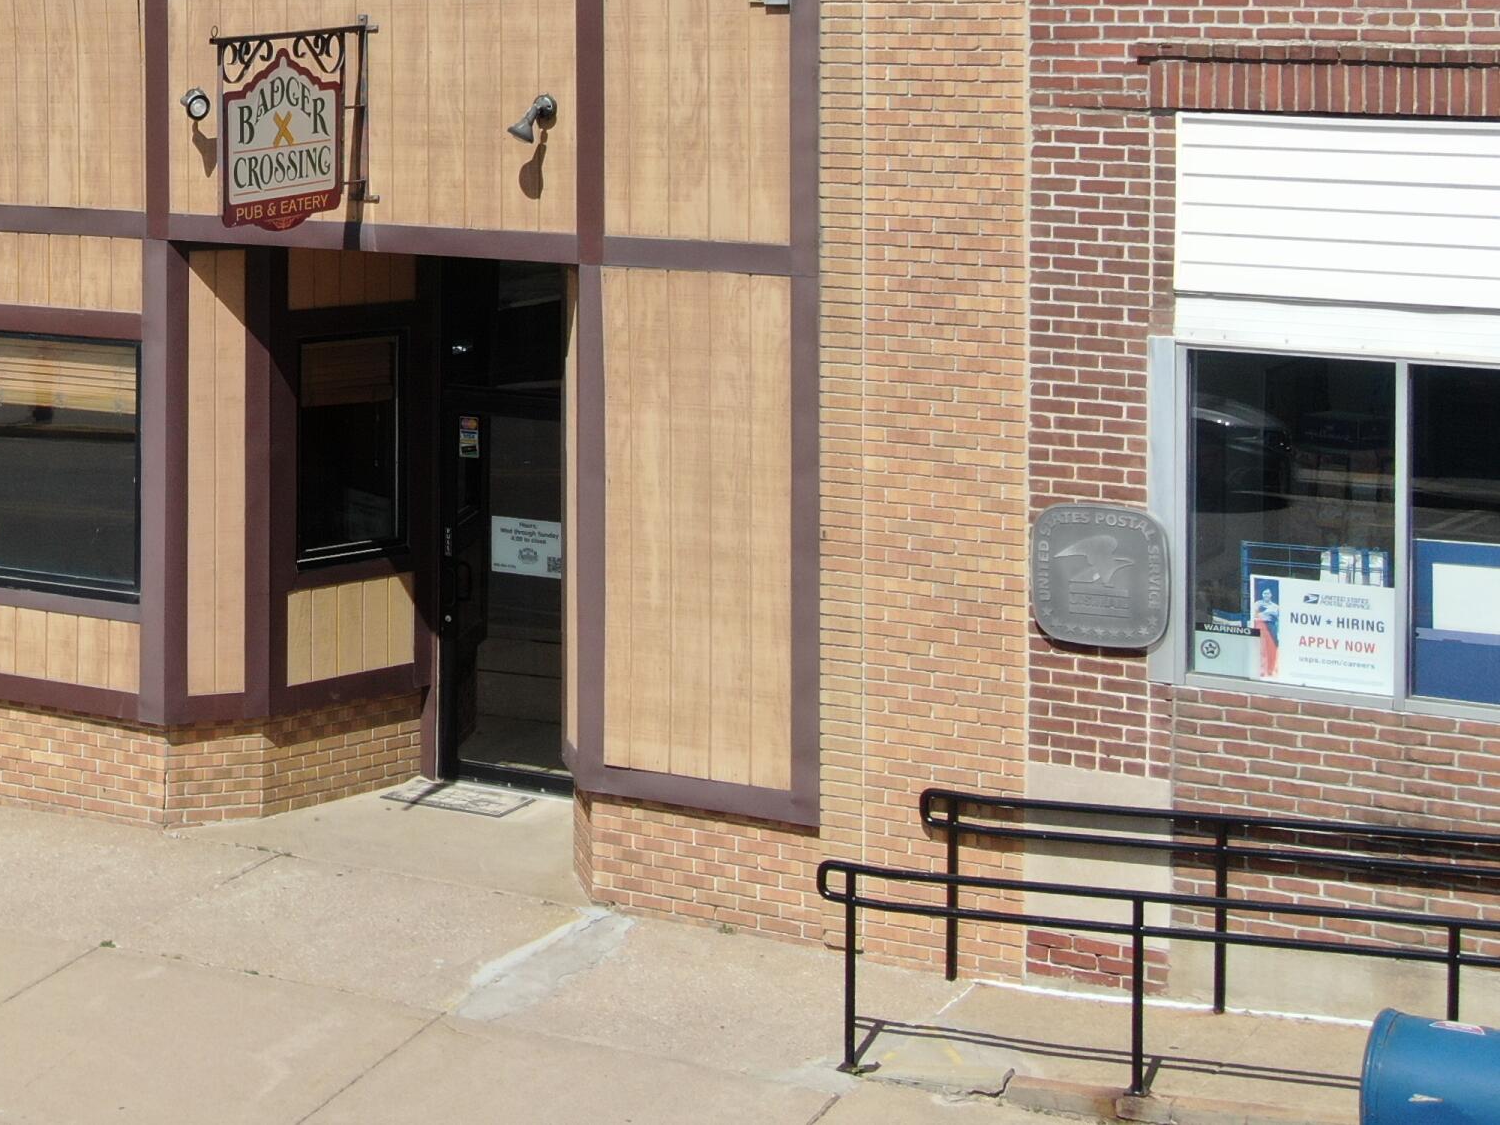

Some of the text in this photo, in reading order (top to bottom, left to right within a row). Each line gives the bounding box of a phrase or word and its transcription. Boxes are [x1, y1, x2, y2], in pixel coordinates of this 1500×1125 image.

[237, 75, 330, 145] BADGER
[233, 145, 331, 190] CROSSING
[236, 194, 330, 221] PUB & EATERY
[1037, 511, 1161, 609] UNITED STATES POSTAL SERVICE
[1203, 623, 1252, 635] WARNING
[1290, 612, 1385, 633] NOW HIRING
[1298, 635, 1376, 654] APPLY NOW
[1298, 655, 1376, 670] usps.com/careers
